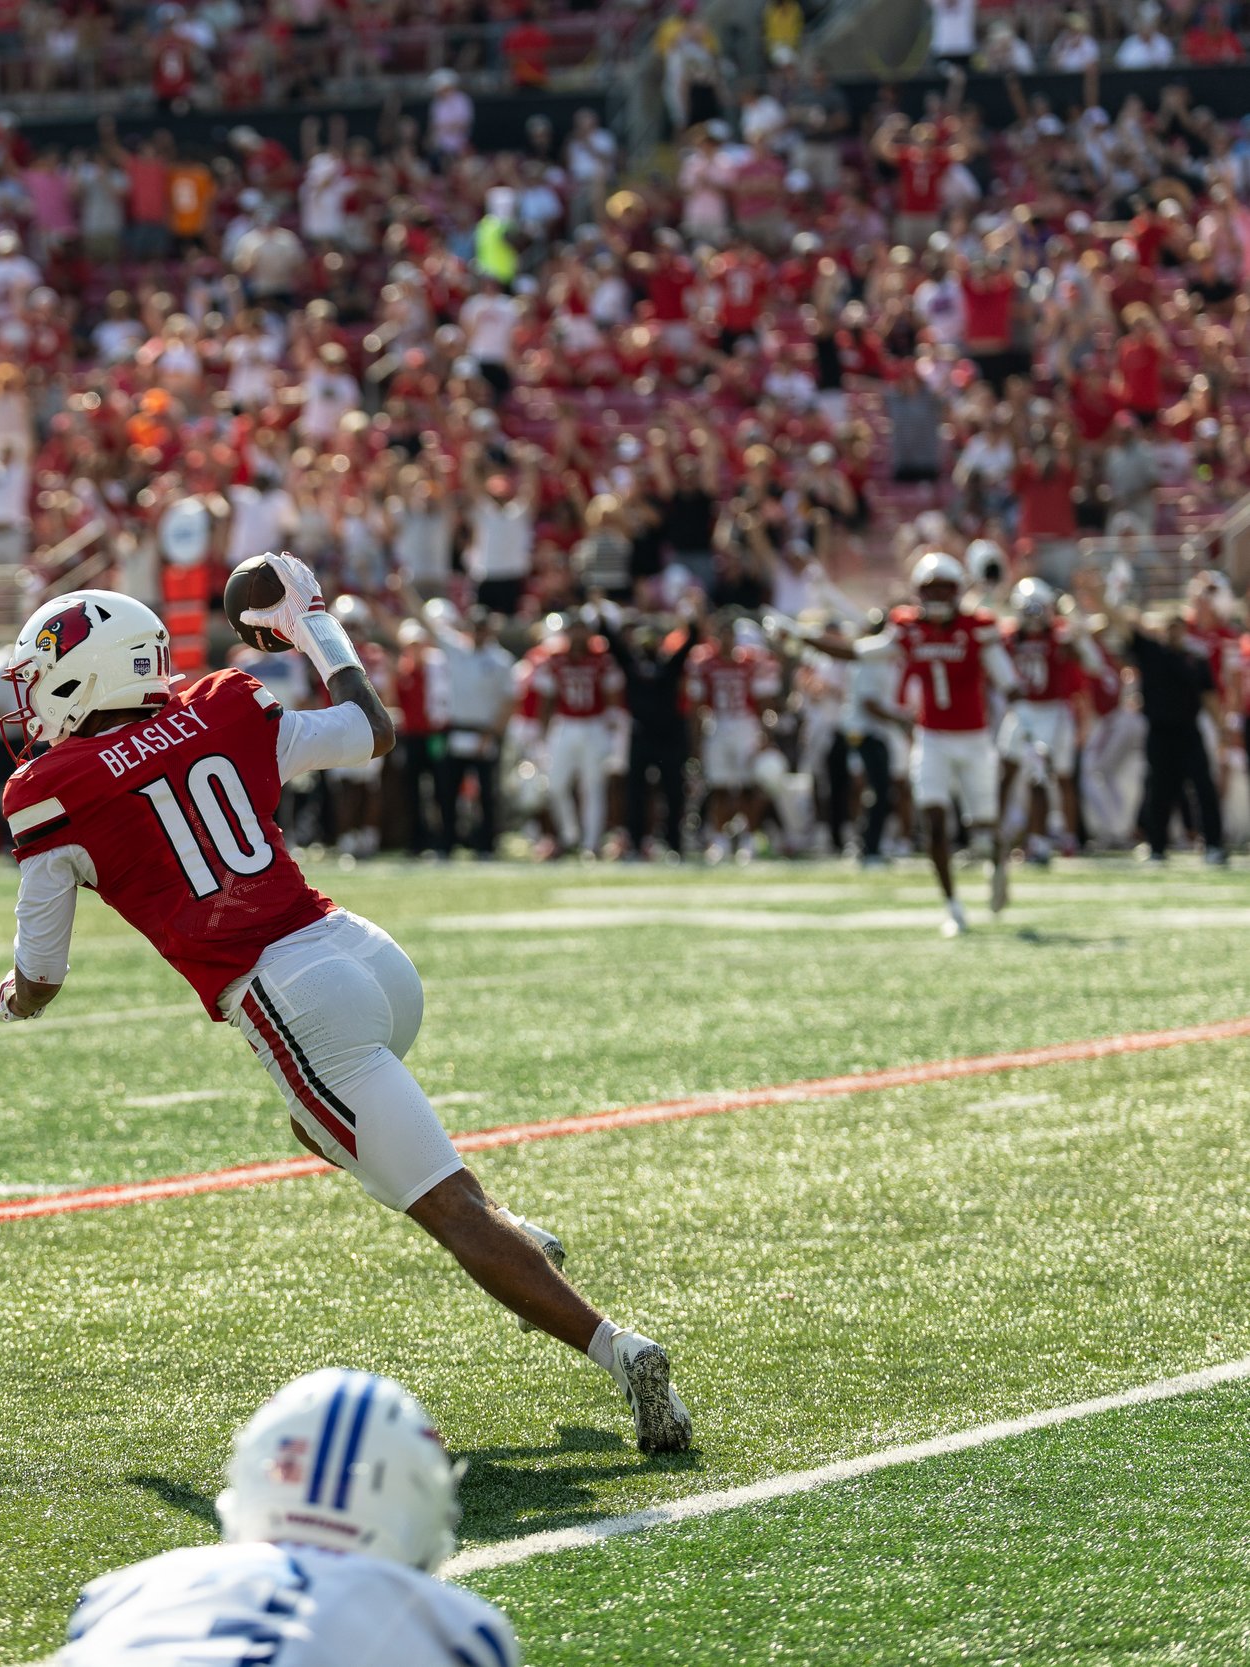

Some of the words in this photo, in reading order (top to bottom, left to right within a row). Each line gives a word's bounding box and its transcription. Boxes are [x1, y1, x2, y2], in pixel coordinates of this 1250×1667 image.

[155, 645, 169, 676] 10
[930, 661, 950, 709] 1
[98, 705, 209, 778] BEASLEY
[133, 754, 276, 900] 10
